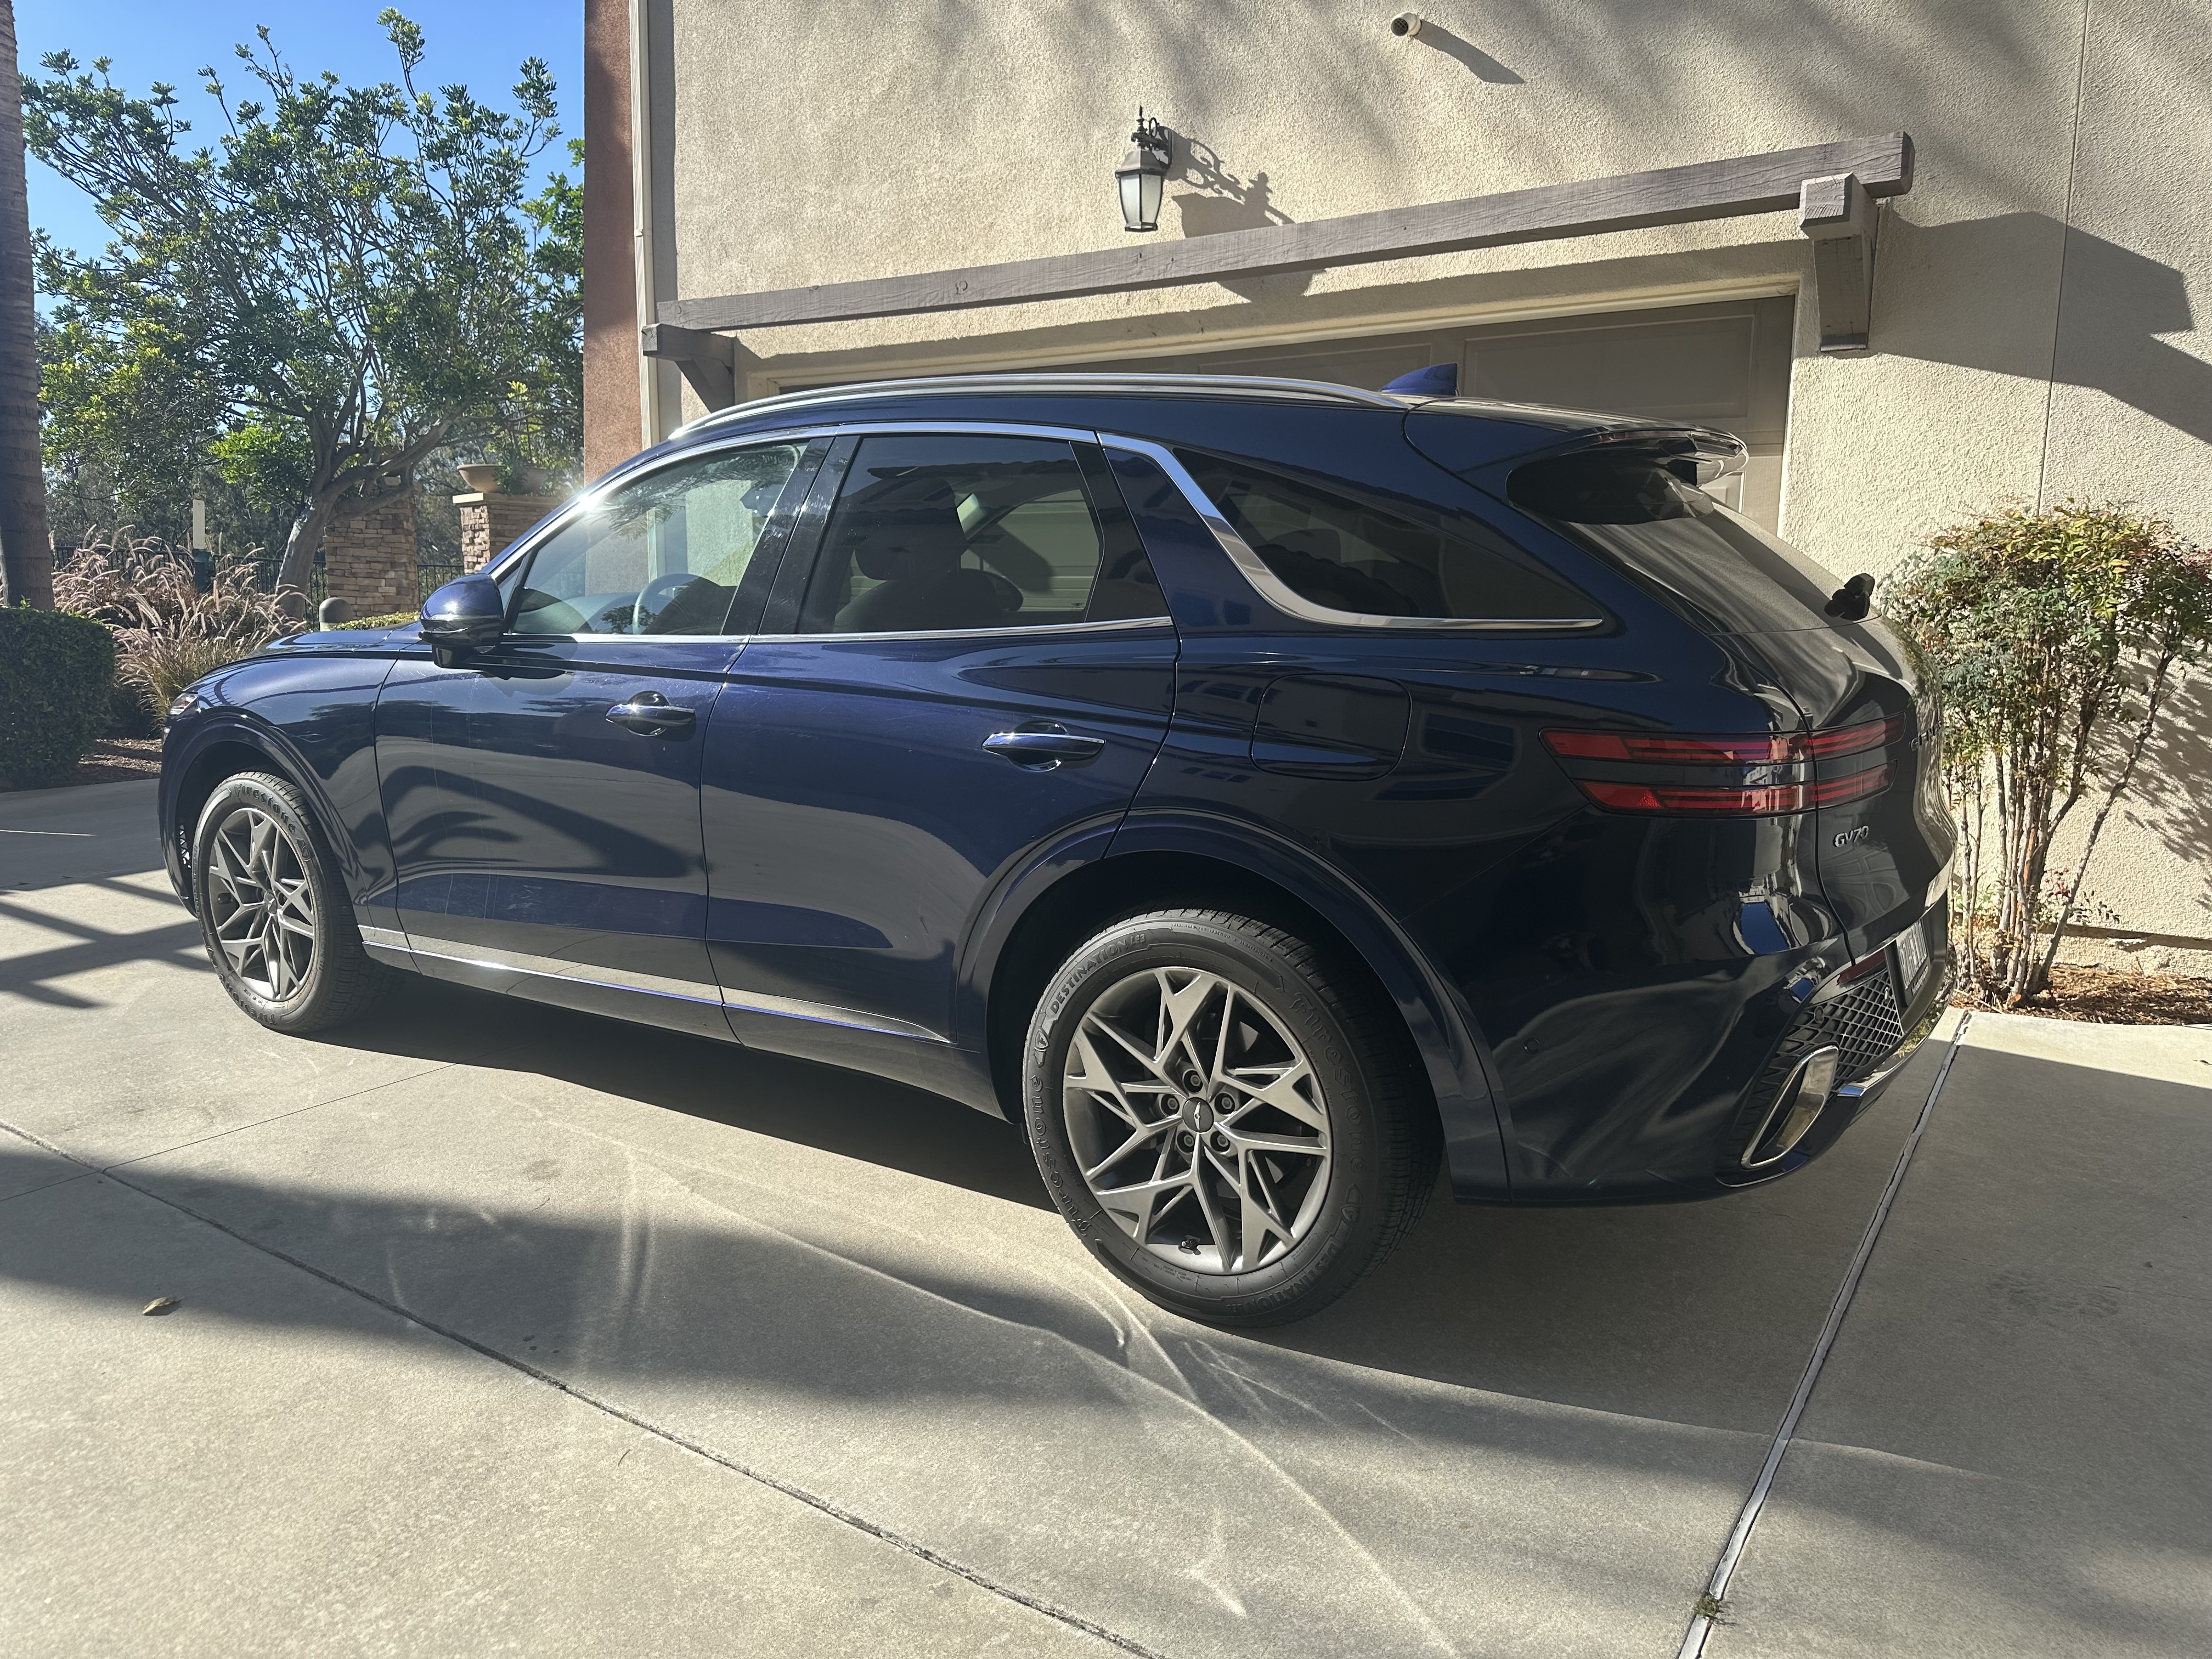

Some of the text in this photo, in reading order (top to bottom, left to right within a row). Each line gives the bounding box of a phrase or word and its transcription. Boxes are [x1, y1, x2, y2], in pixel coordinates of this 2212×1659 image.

[234, 782, 296, 834] Firestone
[1833, 825, 1869, 848] GV70
[1049, 933, 1146, 1014] DESTINATION LE3
[1289, 991, 1367, 1176] Firestone
[1029, 1074, 1093, 1237] Firestone
[1243, 1242, 1340, 1314] DESTINATION
